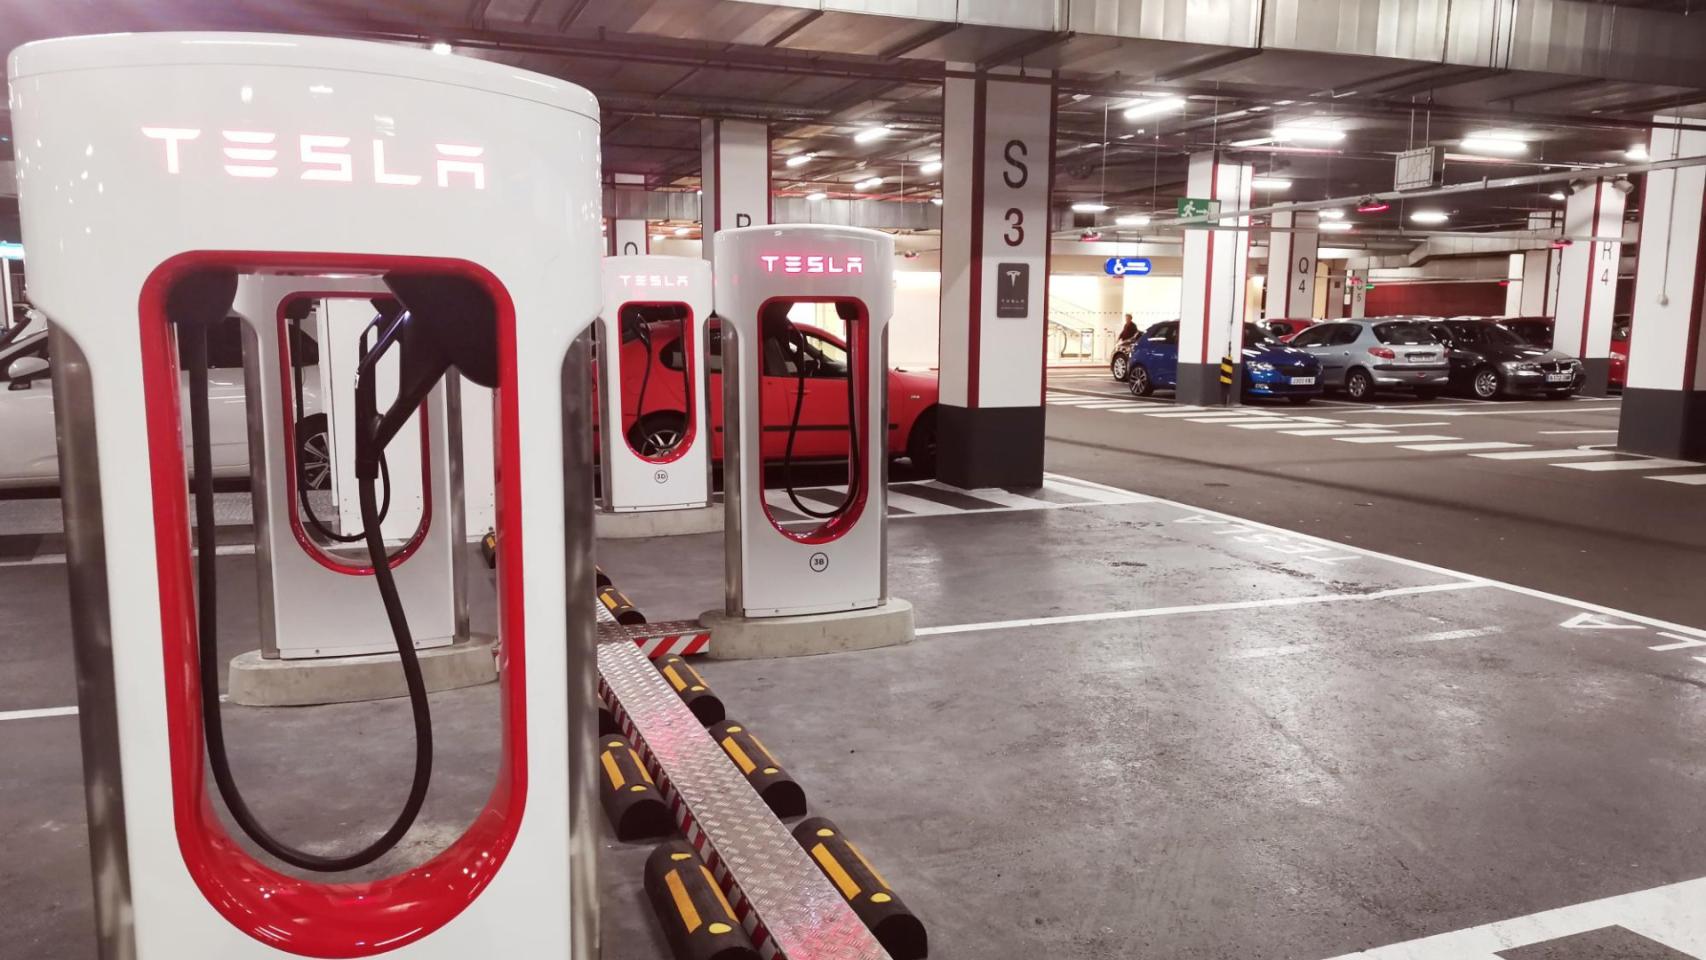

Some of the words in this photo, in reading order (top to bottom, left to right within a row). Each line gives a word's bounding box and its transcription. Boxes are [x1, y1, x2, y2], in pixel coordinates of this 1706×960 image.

[141, 127, 486, 189] TESLA
[1003, 140, 1028, 189] S
[1004, 208, 1025, 247] 3
[761, 256, 863, 273] TESLA
[1299, 257, 1309, 274] Q
[619, 275, 689, 287] TESLA
[1601, 268, 1608, 286] 4
[1299, 280, 1306, 293] 4
